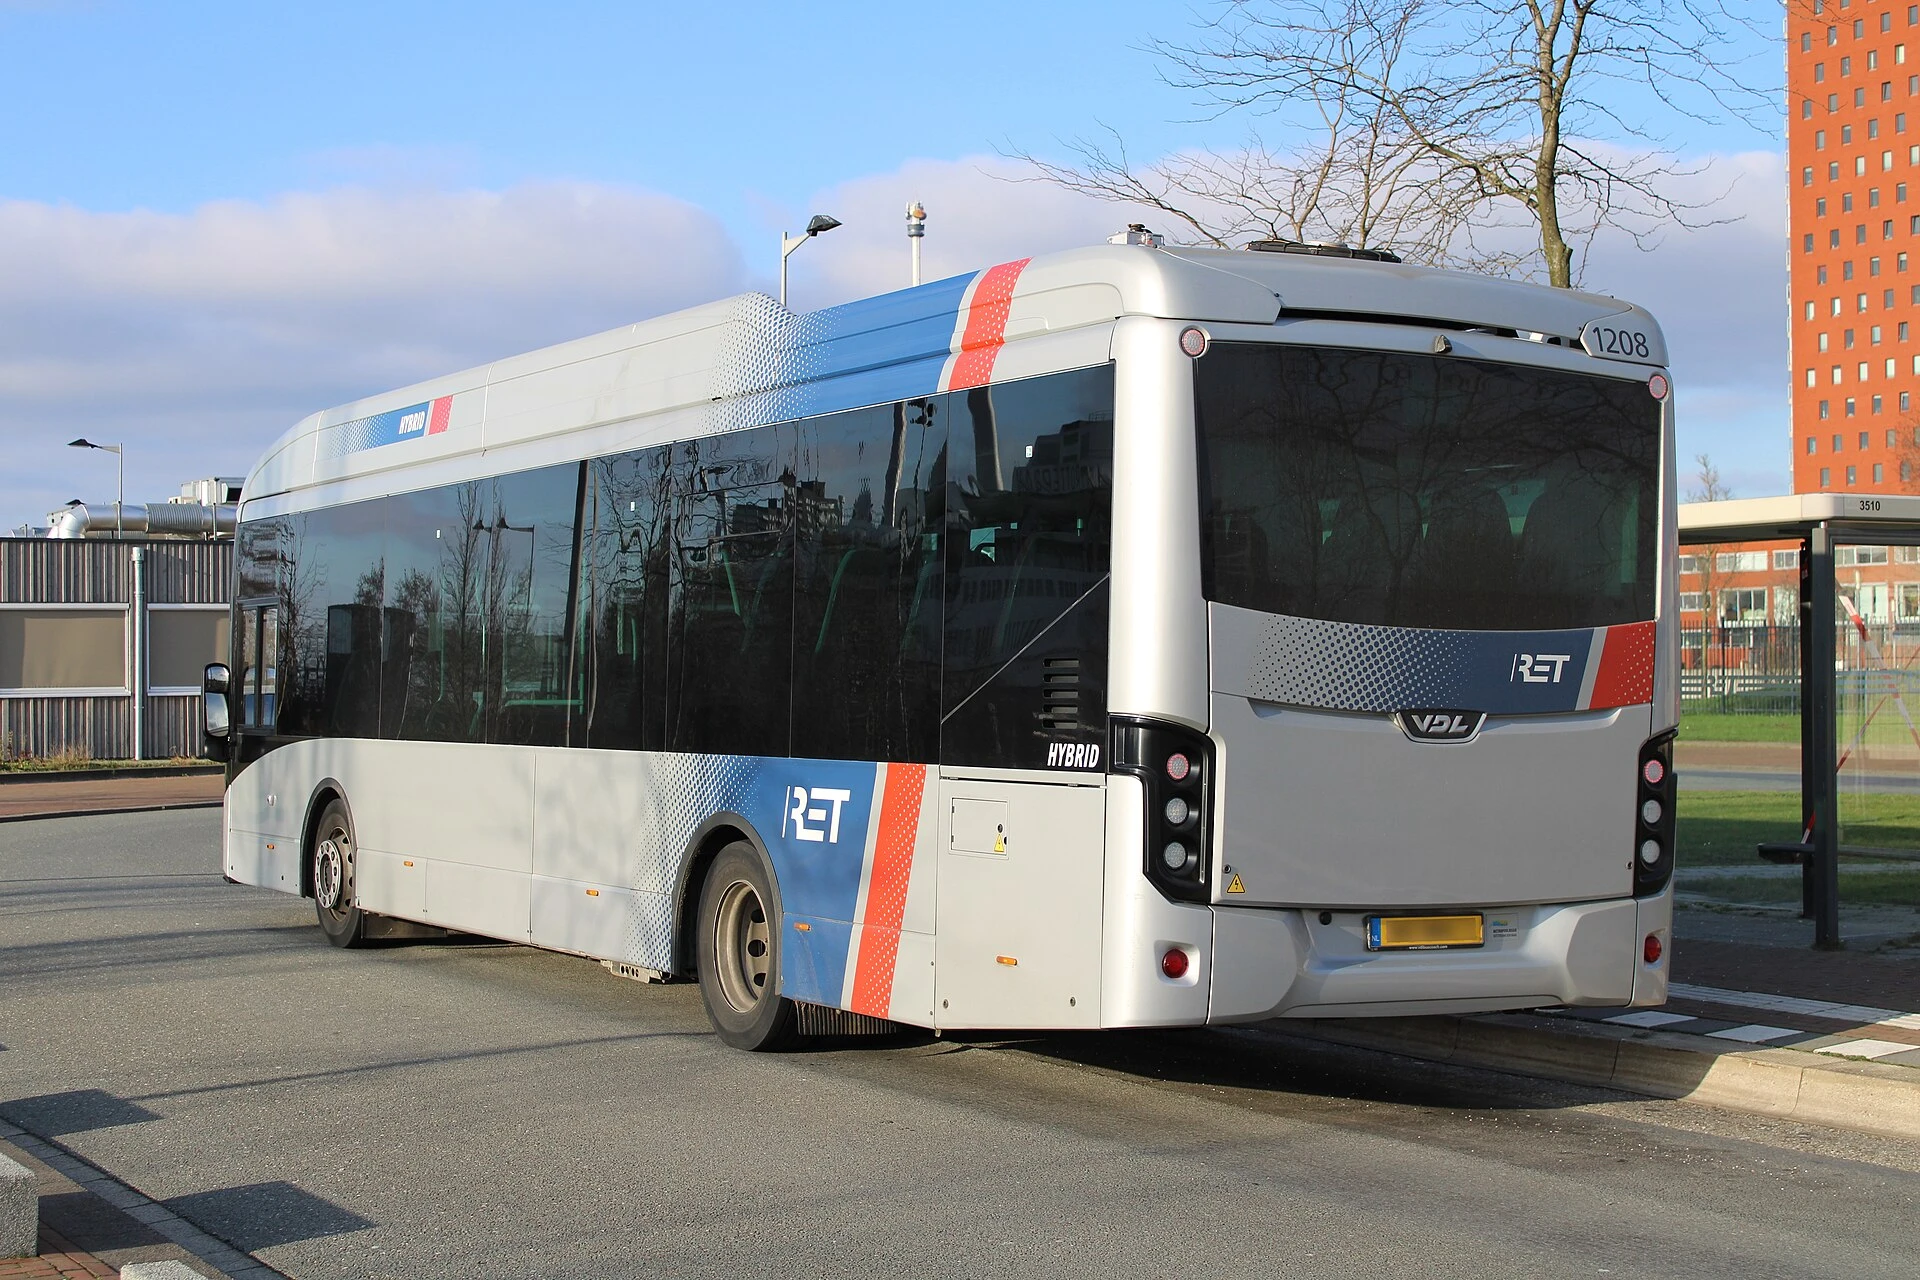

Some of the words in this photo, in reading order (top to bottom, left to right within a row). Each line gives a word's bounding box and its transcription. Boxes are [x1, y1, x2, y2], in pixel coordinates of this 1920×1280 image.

[1592, 326, 1650, 358] 1208
[398, 411, 426, 435] HYBRID
[1859, 500, 1881, 511] 3510
[1510, 653, 1571, 683] RET
[1411, 714, 1469, 733] VDL
[1046, 742, 1100, 768] HYBRID
[781, 785, 851, 844] RET
[1371, 934, 1380, 942] NL
